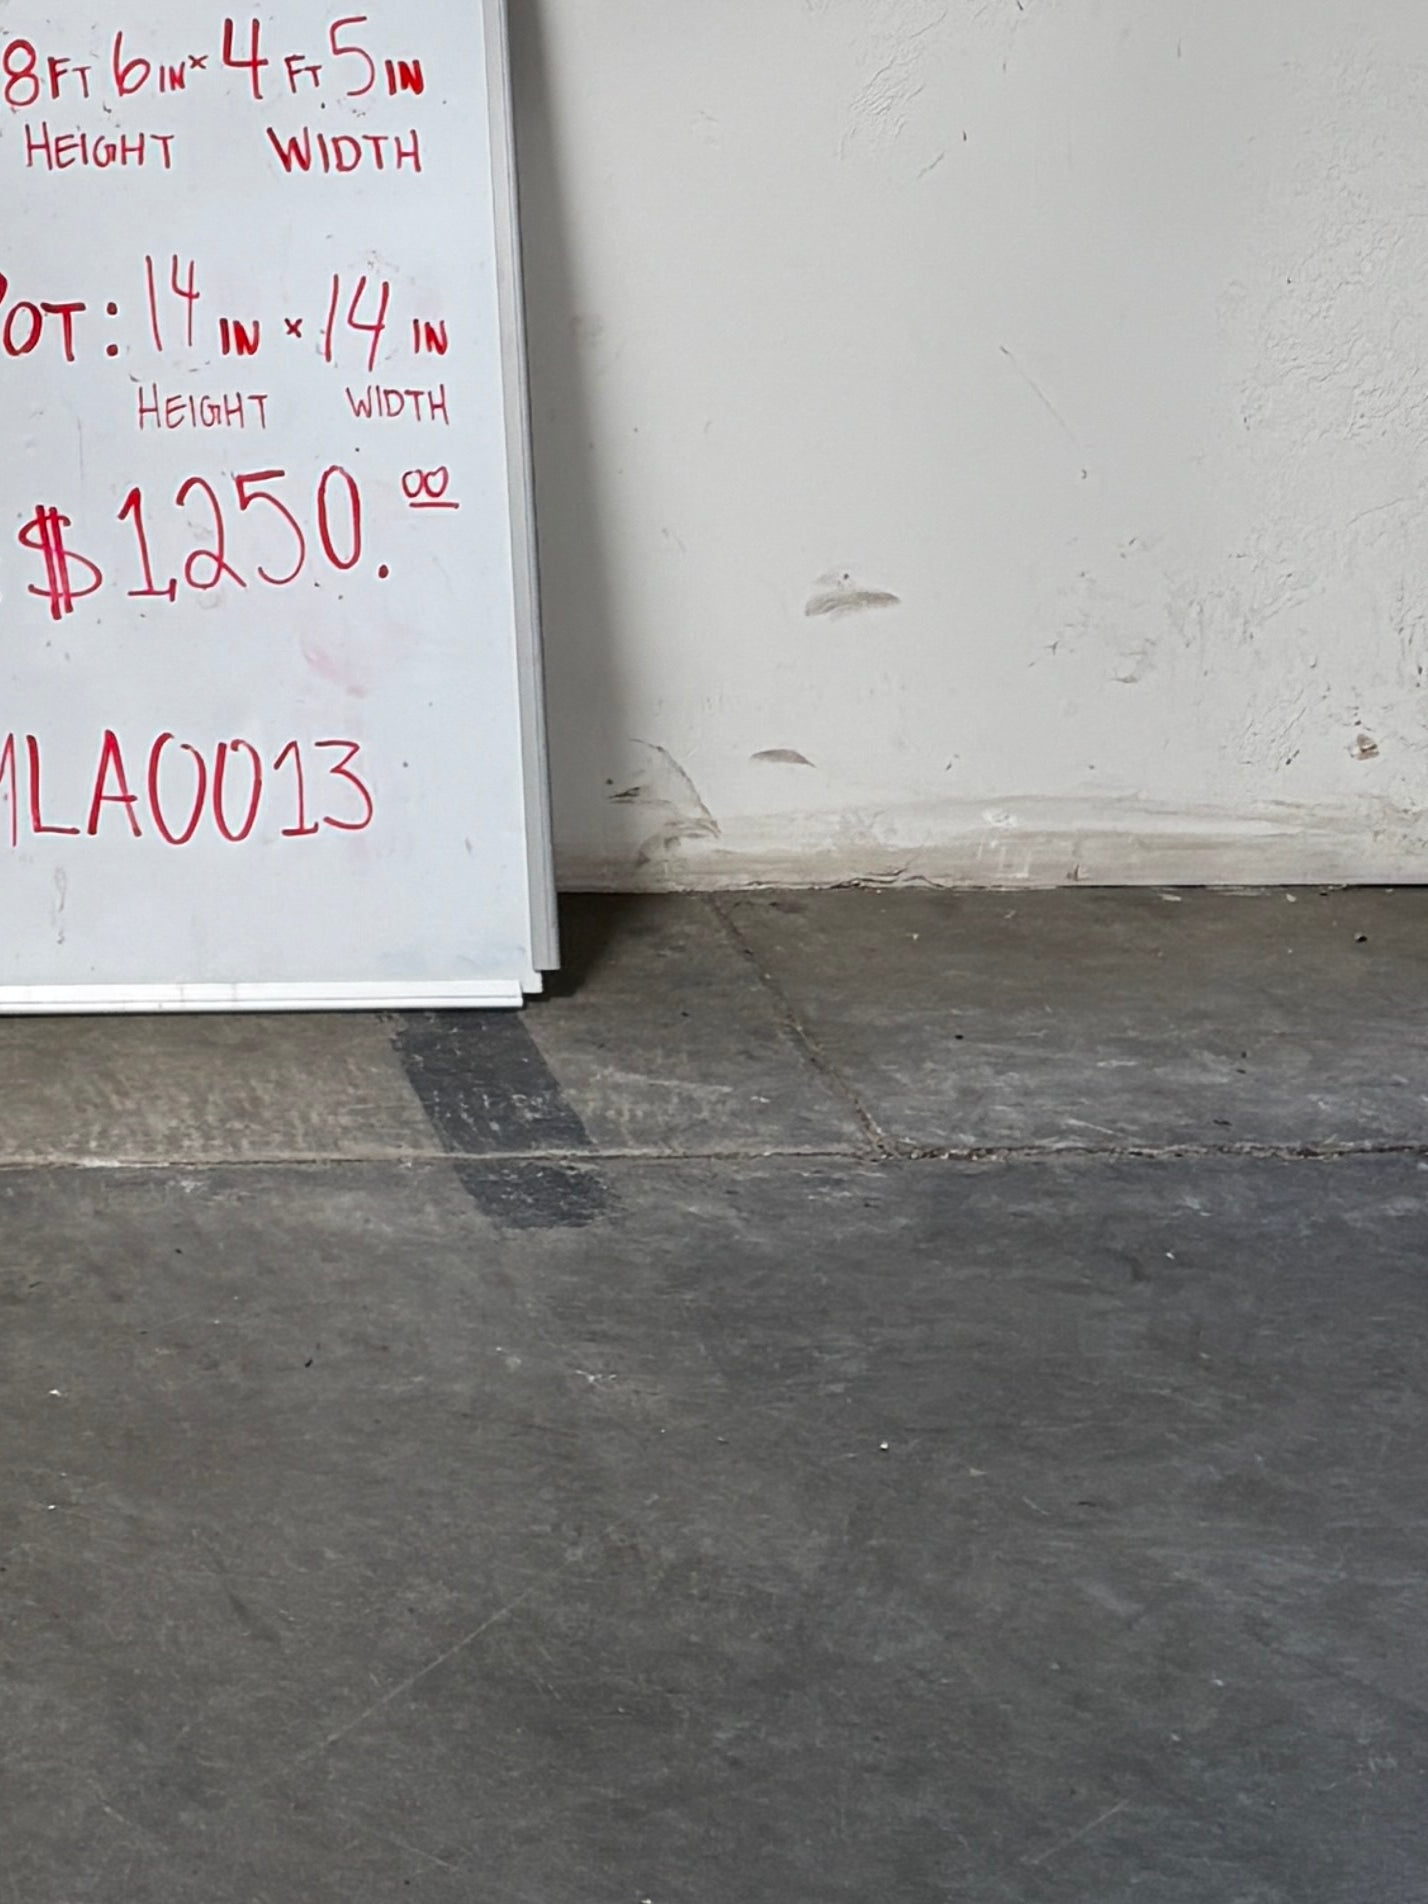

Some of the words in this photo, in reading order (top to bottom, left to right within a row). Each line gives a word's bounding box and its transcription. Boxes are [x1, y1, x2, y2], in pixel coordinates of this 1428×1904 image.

[24, 120, 176, 171] HEIGHT
[265, 126, 422, 173] WIDTH
[138, 383, 268, 430] HEIGHT
[346, 384, 449, 427] WIDTH
